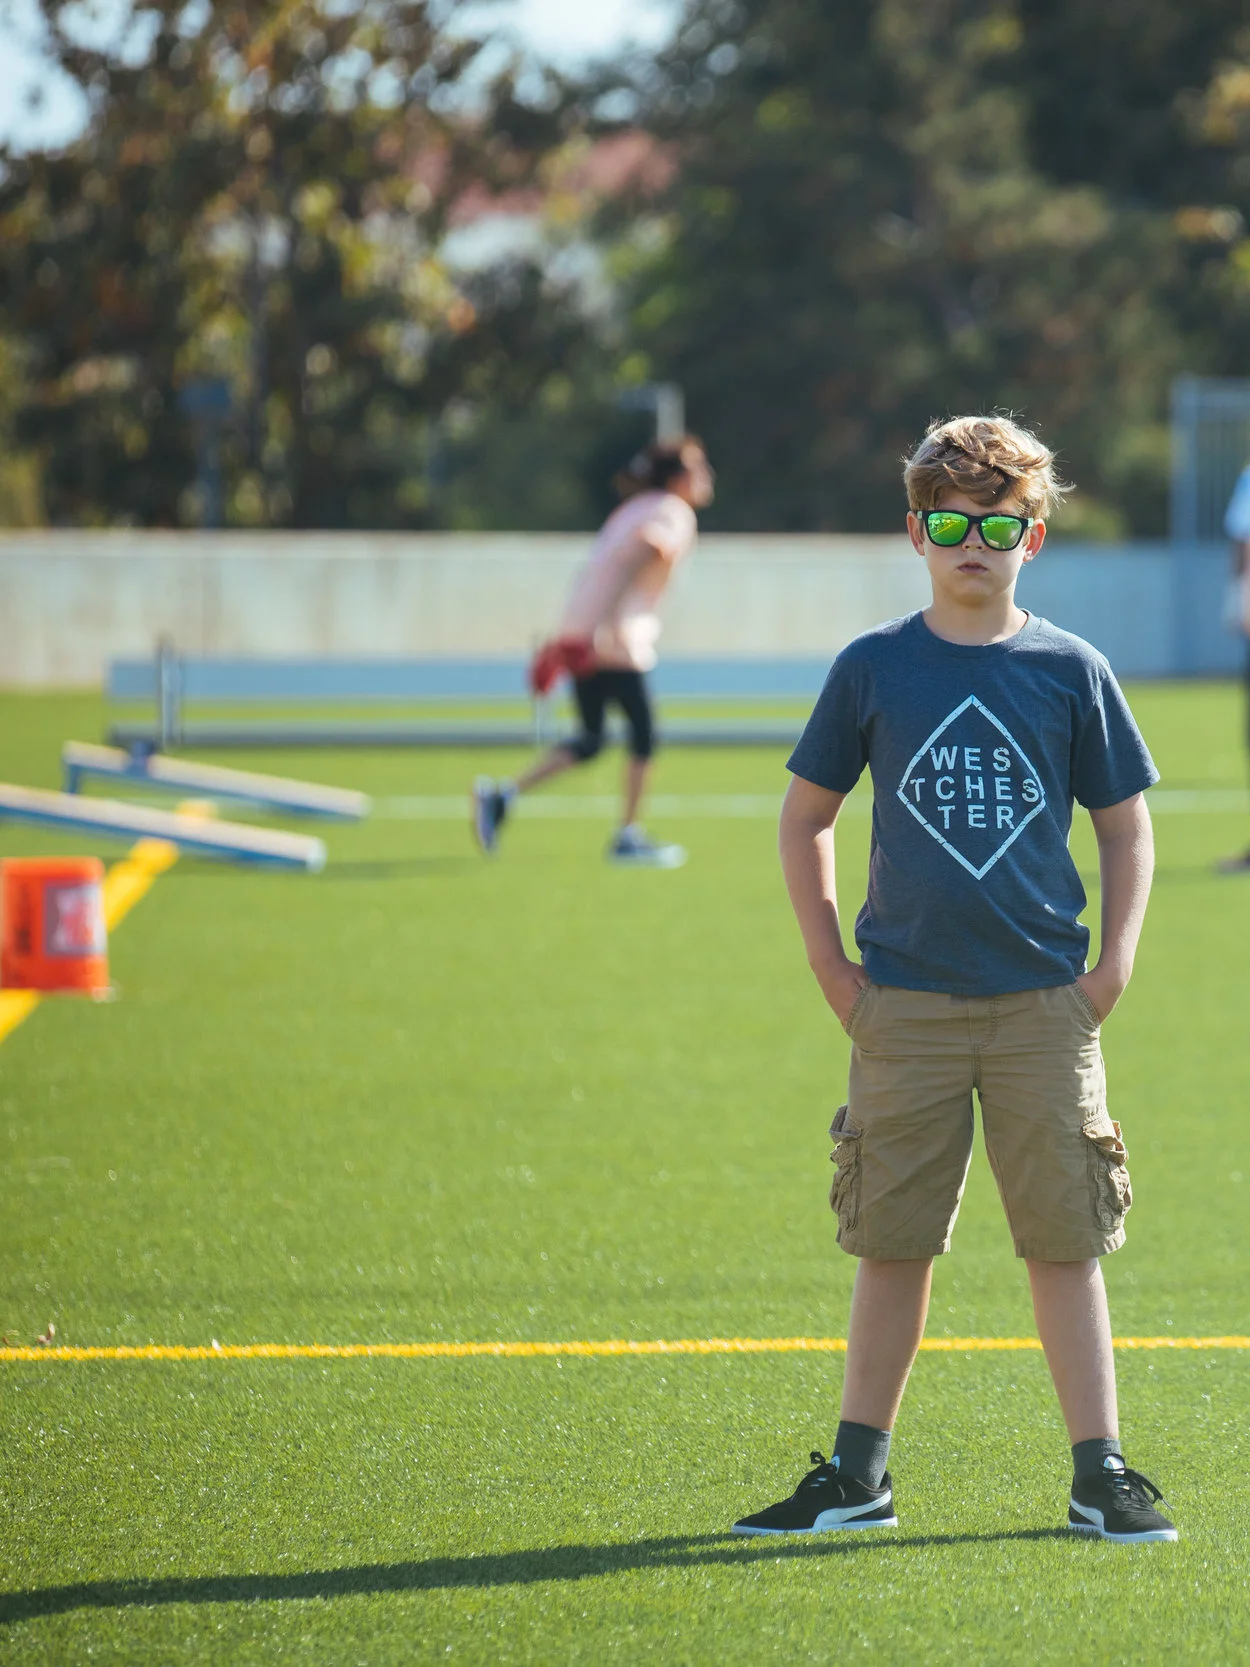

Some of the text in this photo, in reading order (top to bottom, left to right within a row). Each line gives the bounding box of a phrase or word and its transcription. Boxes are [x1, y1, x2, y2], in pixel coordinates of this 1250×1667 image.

[930, 746, 1011, 771] WES
[910, 776, 1039, 802] TCHES
[938, 805, 1015, 829] TER
